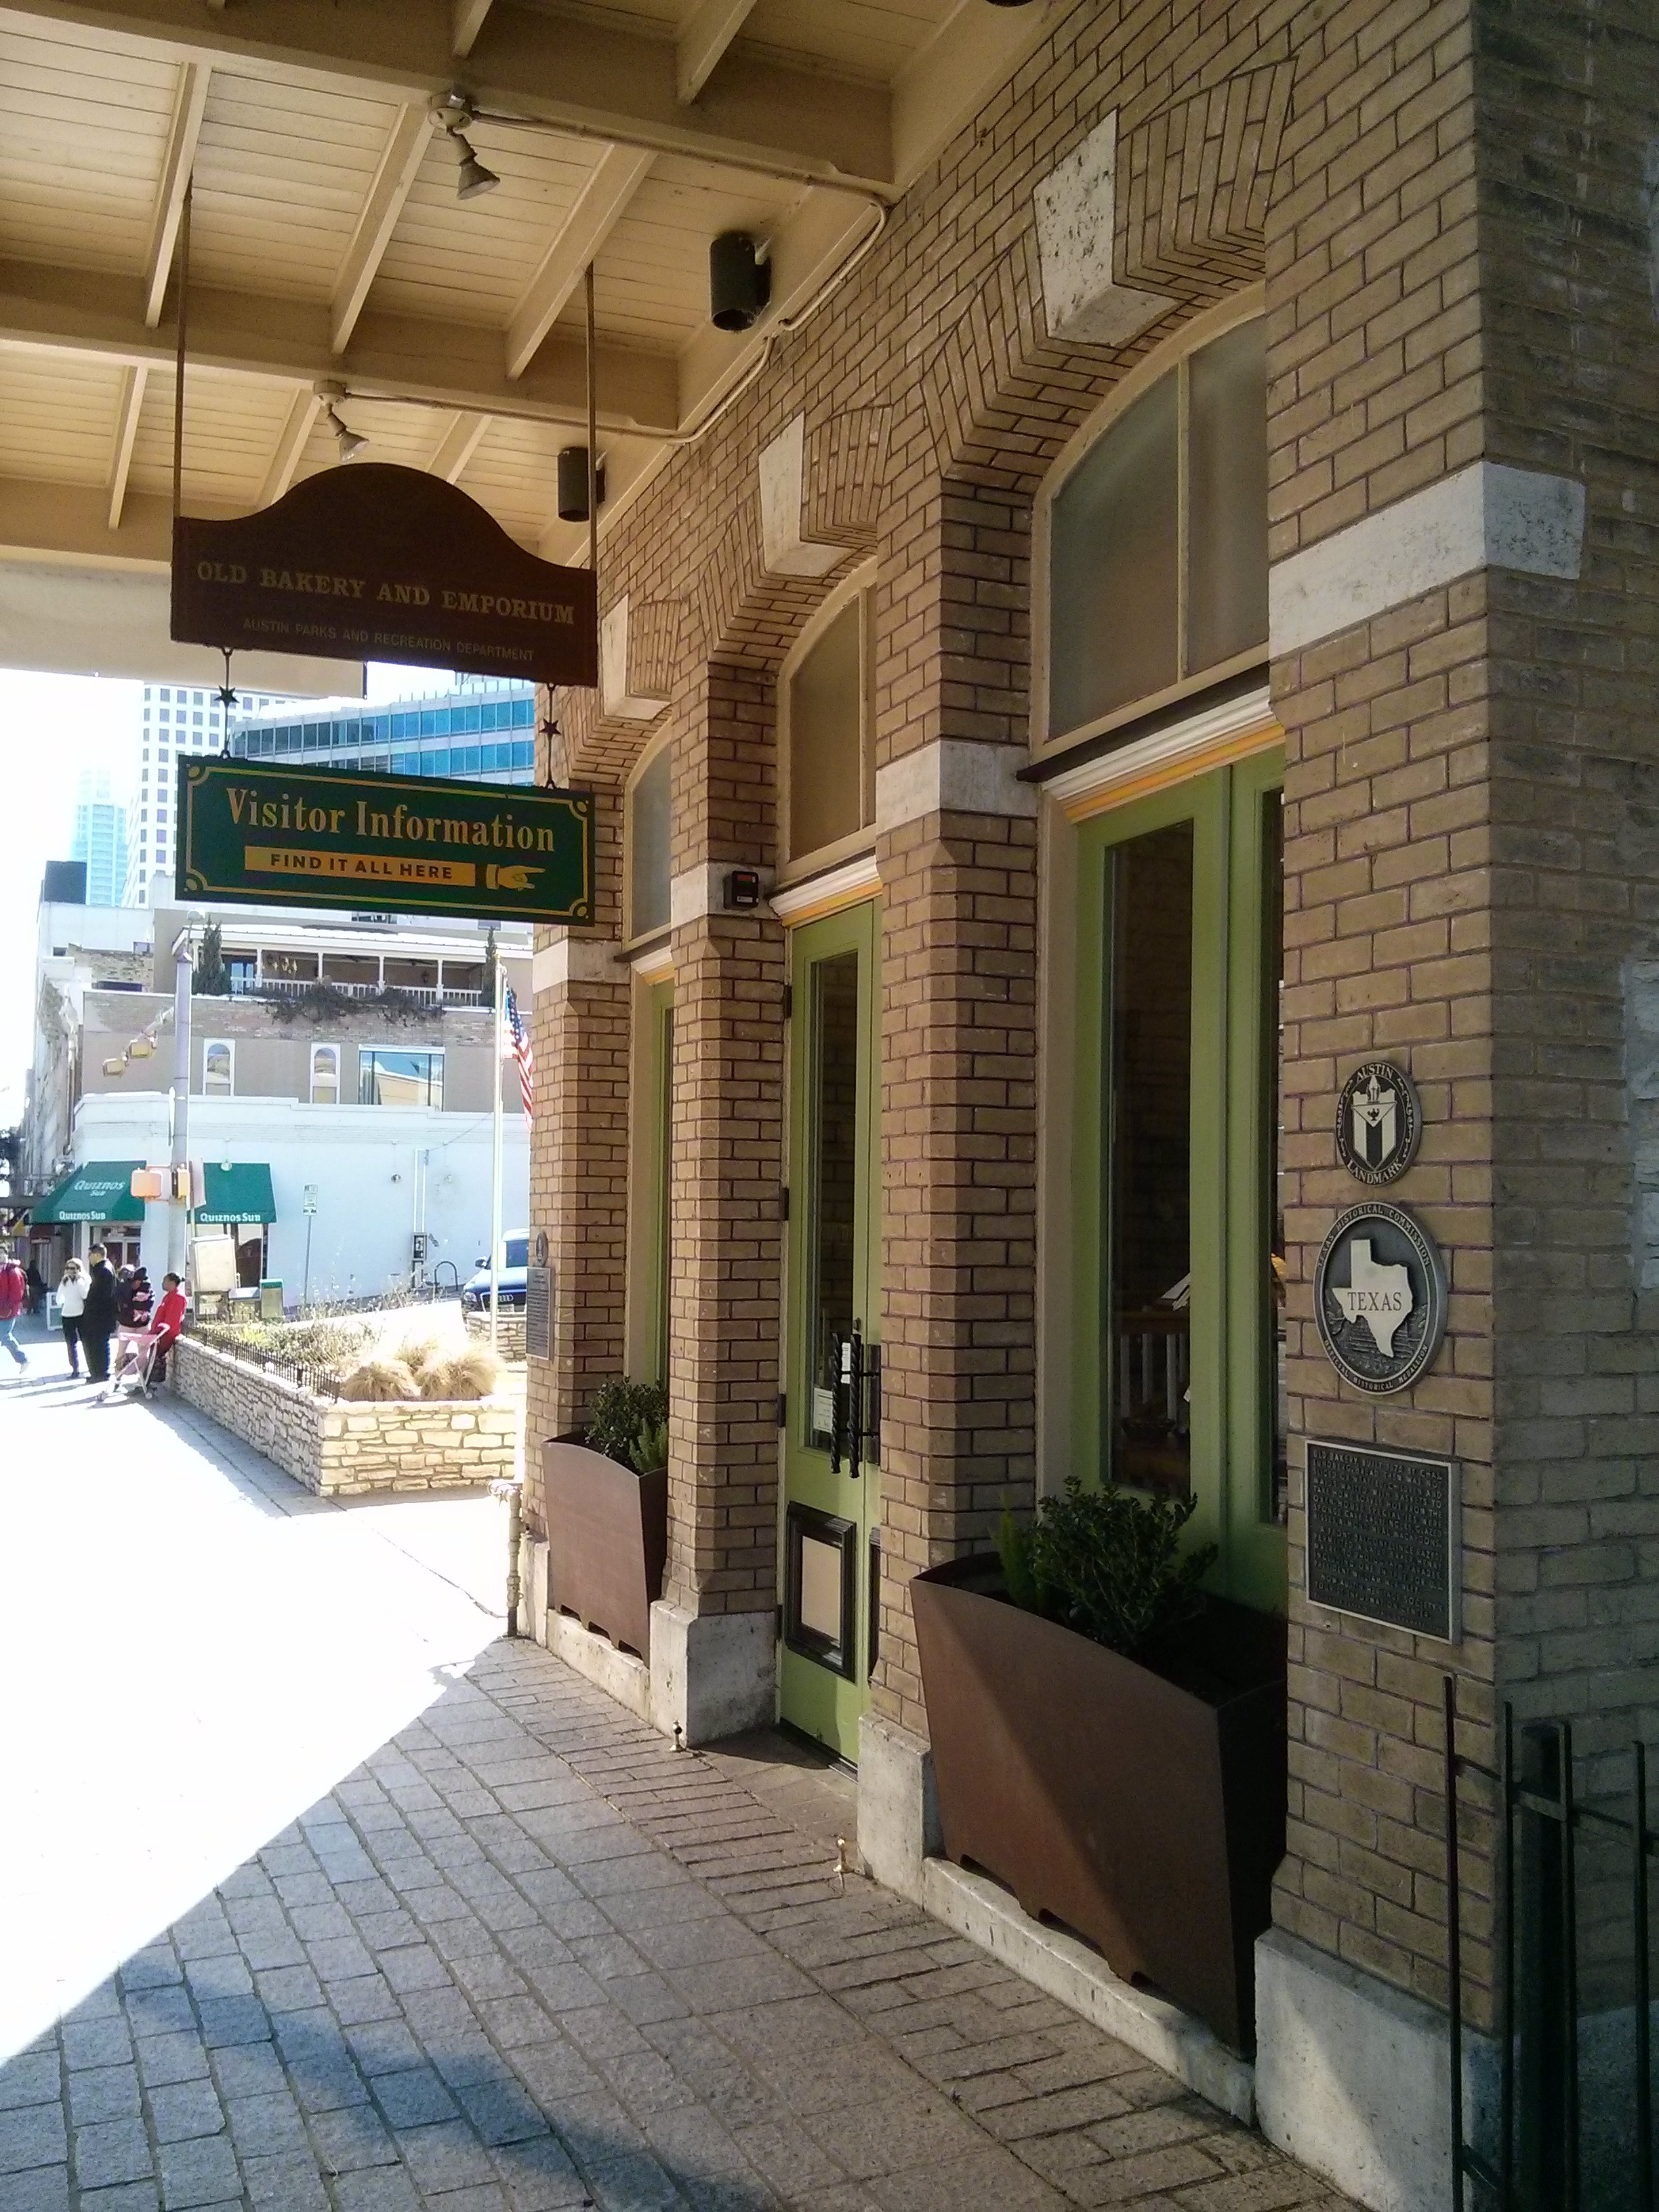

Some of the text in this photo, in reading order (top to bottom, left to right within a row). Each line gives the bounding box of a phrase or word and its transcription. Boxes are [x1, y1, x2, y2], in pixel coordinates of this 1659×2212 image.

[197, 562, 576, 625] OLD BAKERY AND EMPORIUM
[243, 619, 534, 662] AUSTIN PARKS AND RECREATION DEPARTMENT
[226, 787, 556, 853] Visitor Information
[270, 853, 453, 880] FIND IT ALL HERE
[1356, 1063, 1393, 1081] AUSTIN
[1347, 1160, 1402, 1185] LANDMARK
[1336, 1206, 1383, 1231] HISTORICAL
[1389, 1210, 1431, 1267] COMMISSION
[1348, 1292, 1402, 1311] TEXAS
[1353, 1376, 1393, 1391] HISTORICAL
[1399, 1345, 1429, 1382] MEDALLION
